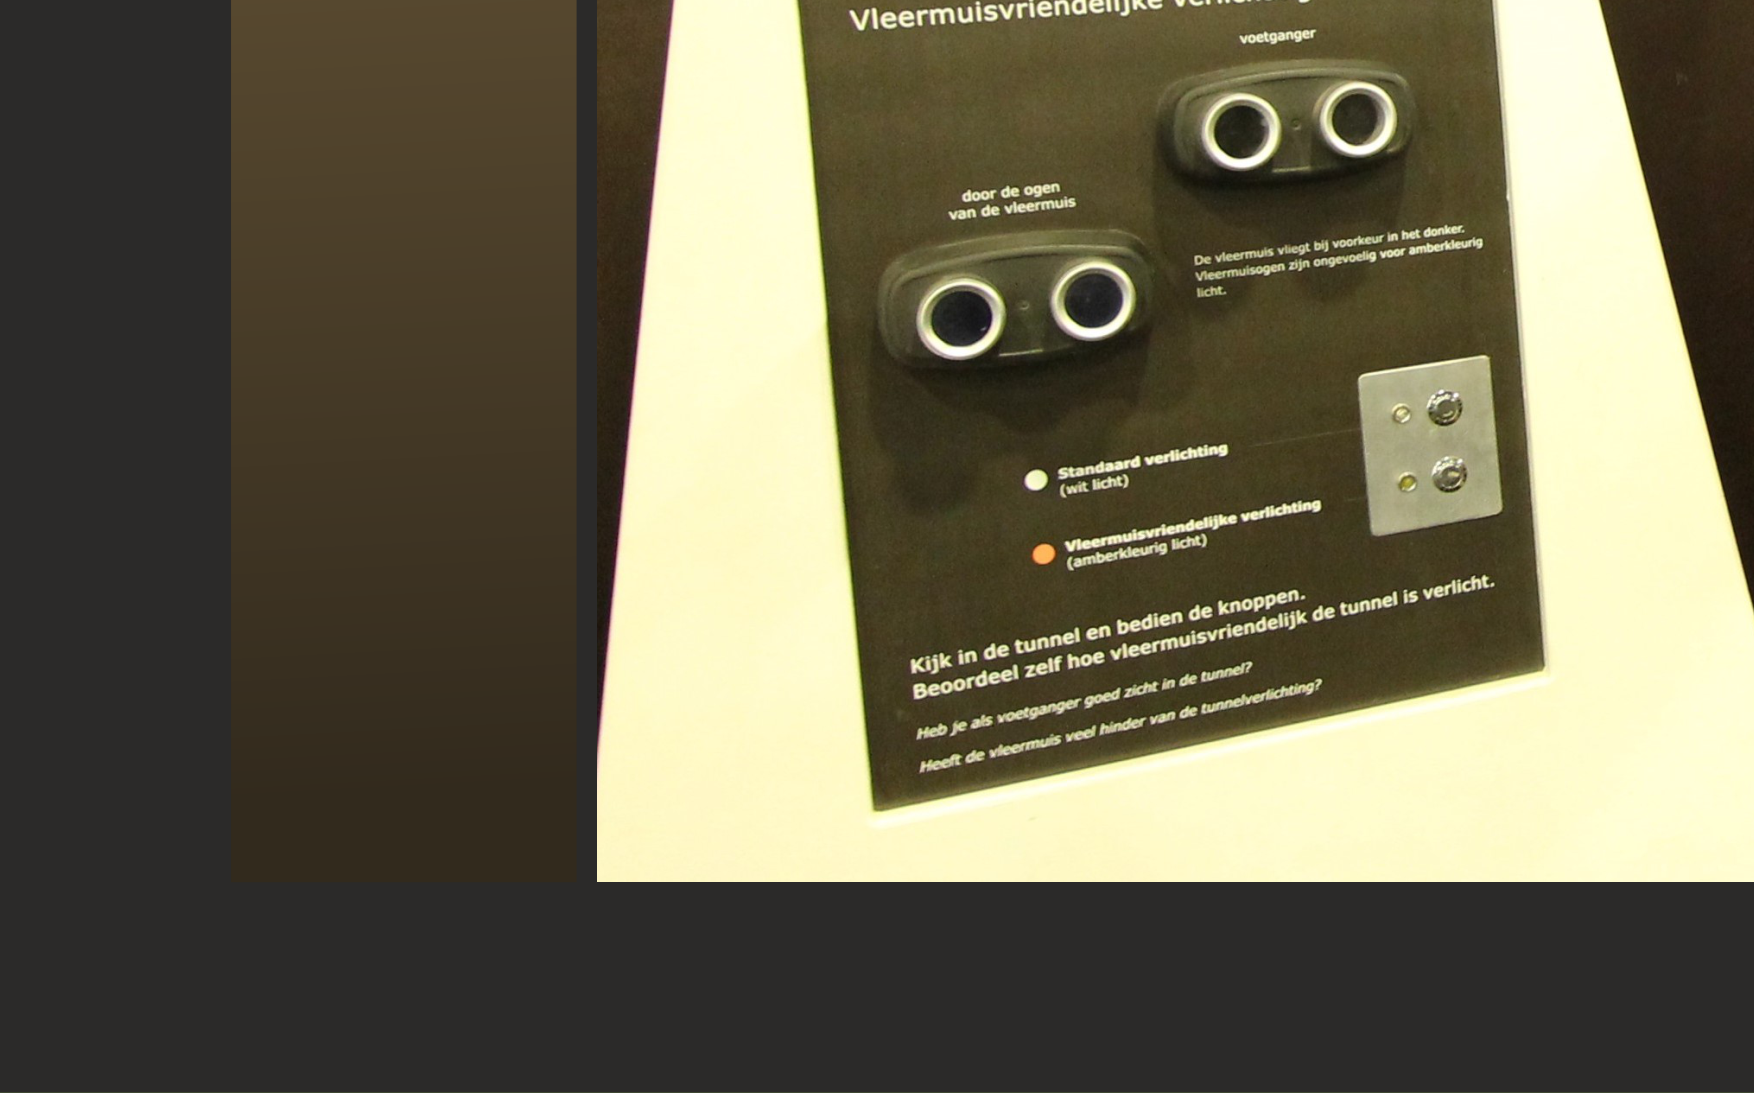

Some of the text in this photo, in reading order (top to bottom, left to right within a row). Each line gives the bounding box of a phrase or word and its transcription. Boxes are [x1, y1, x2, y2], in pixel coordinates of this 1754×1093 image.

[1239, 29, 1315, 45] voetganger
[948, 196, 1076, 221] van de vleermuis
[961, 183, 1060, 202] door de ogen
[1193, 223, 1465, 266] De vleermuis vliegt bij voorkeur in het donker.
[1195, 236, 1484, 282] Vleermuisogen zijn ongevoelig voor amberkleurig
[1195, 282, 1226, 298] licht.
[1057, 443, 1228, 480] Standaard verlichting
[1059, 473, 1129, 498] (wit licht)
[1064, 499, 1321, 552] Vleermuisvriendelijke verlichting
[1066, 533, 1207, 571] (amberkleurig licht)
[909, 589, 1306, 674] Kijk in de tunnel en bedien de knoppen.
[912, 574, 1495, 700] Beoordeel zelf hoe vleermuisvriendelijk de tunnel is verlicht.
[915, 661, 1252, 739] Heb je als voetganger goed zicht in de tunnel?
[918, 678, 1322, 773] Heeft de vleermuis veel hinder van de tunnelverlichting?
